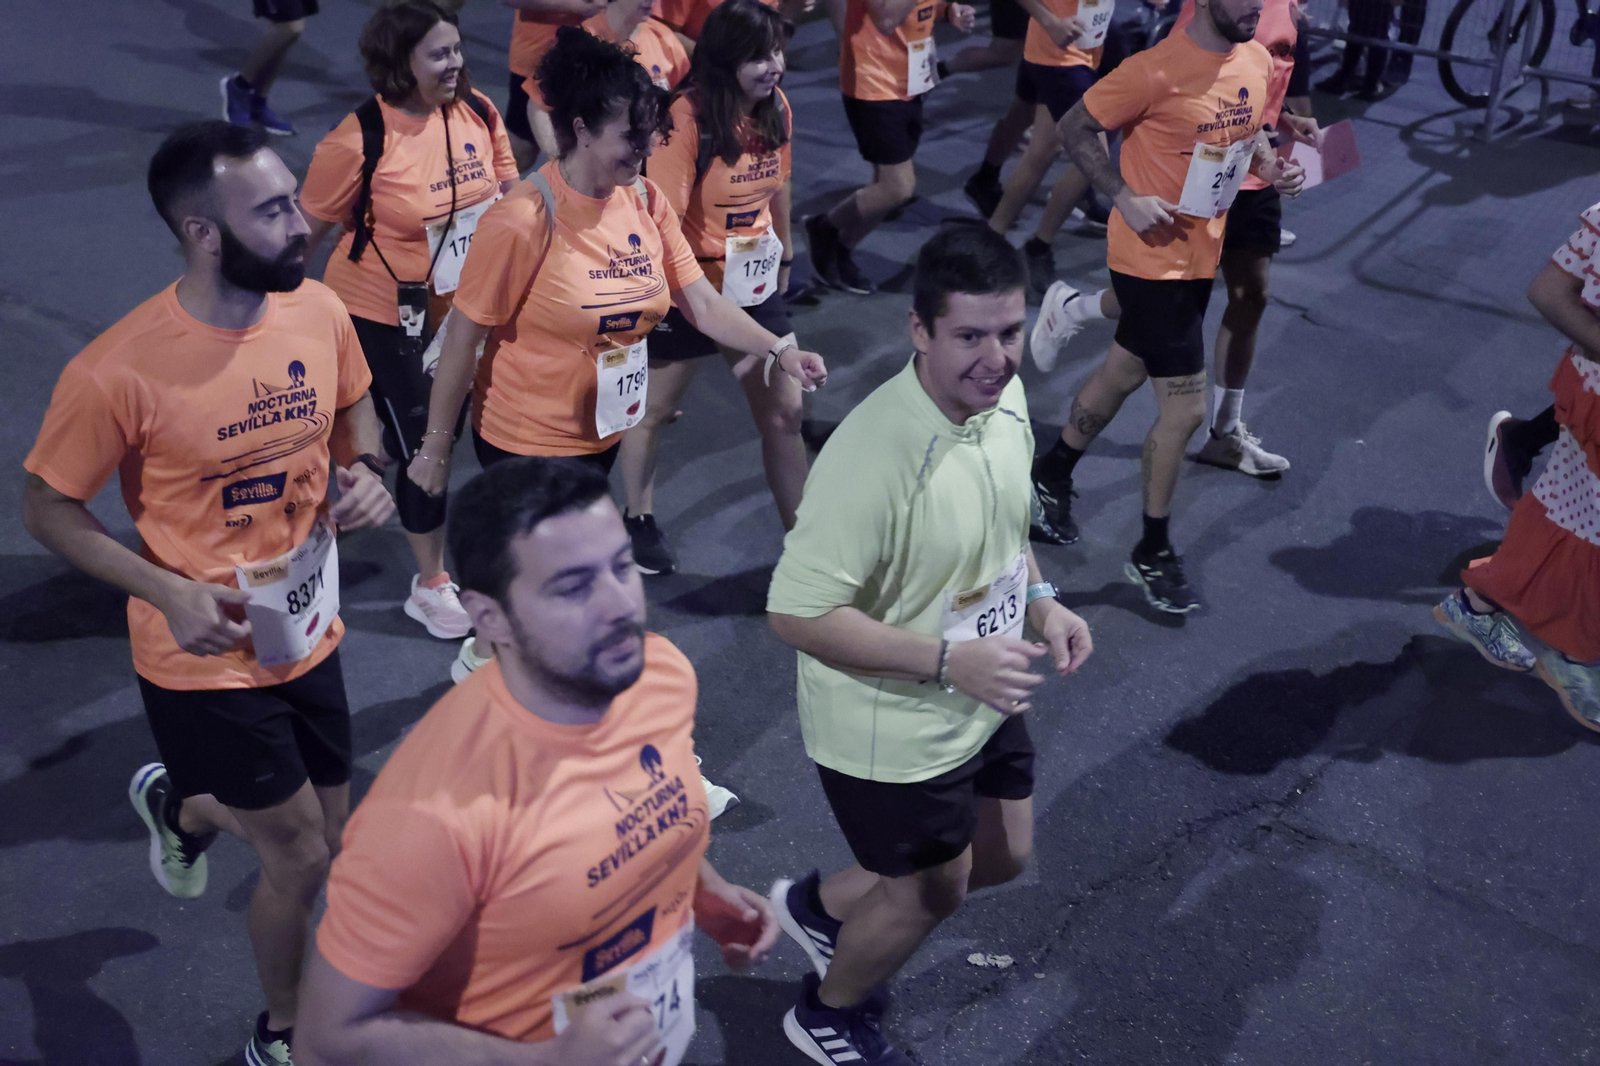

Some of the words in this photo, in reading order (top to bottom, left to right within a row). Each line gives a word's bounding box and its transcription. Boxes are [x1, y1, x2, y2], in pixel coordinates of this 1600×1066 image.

[1197, 119, 1231, 133] SEVILLA
[1231, 115, 1252, 127] KH7
[1215, 106, 1253, 120] NOCTURNA
[730, 171, 765, 184] SEVILLA
[588, 267, 632, 279] SEVILLA
[632, 262, 653, 276] KH7
[248, 387, 317, 415] NOCTURNA
[217, 411, 282, 441] SEVILLA
[285, 400, 317, 421] KH7
[231, 482, 275, 502] Sevilla
[286, 565, 324, 616] 8371
[977, 594, 1017, 638] 6213
[615, 776, 684, 840] NOCTURNA
[587, 824, 656, 888] SEVILLA
[656, 793, 688, 834] KH7
